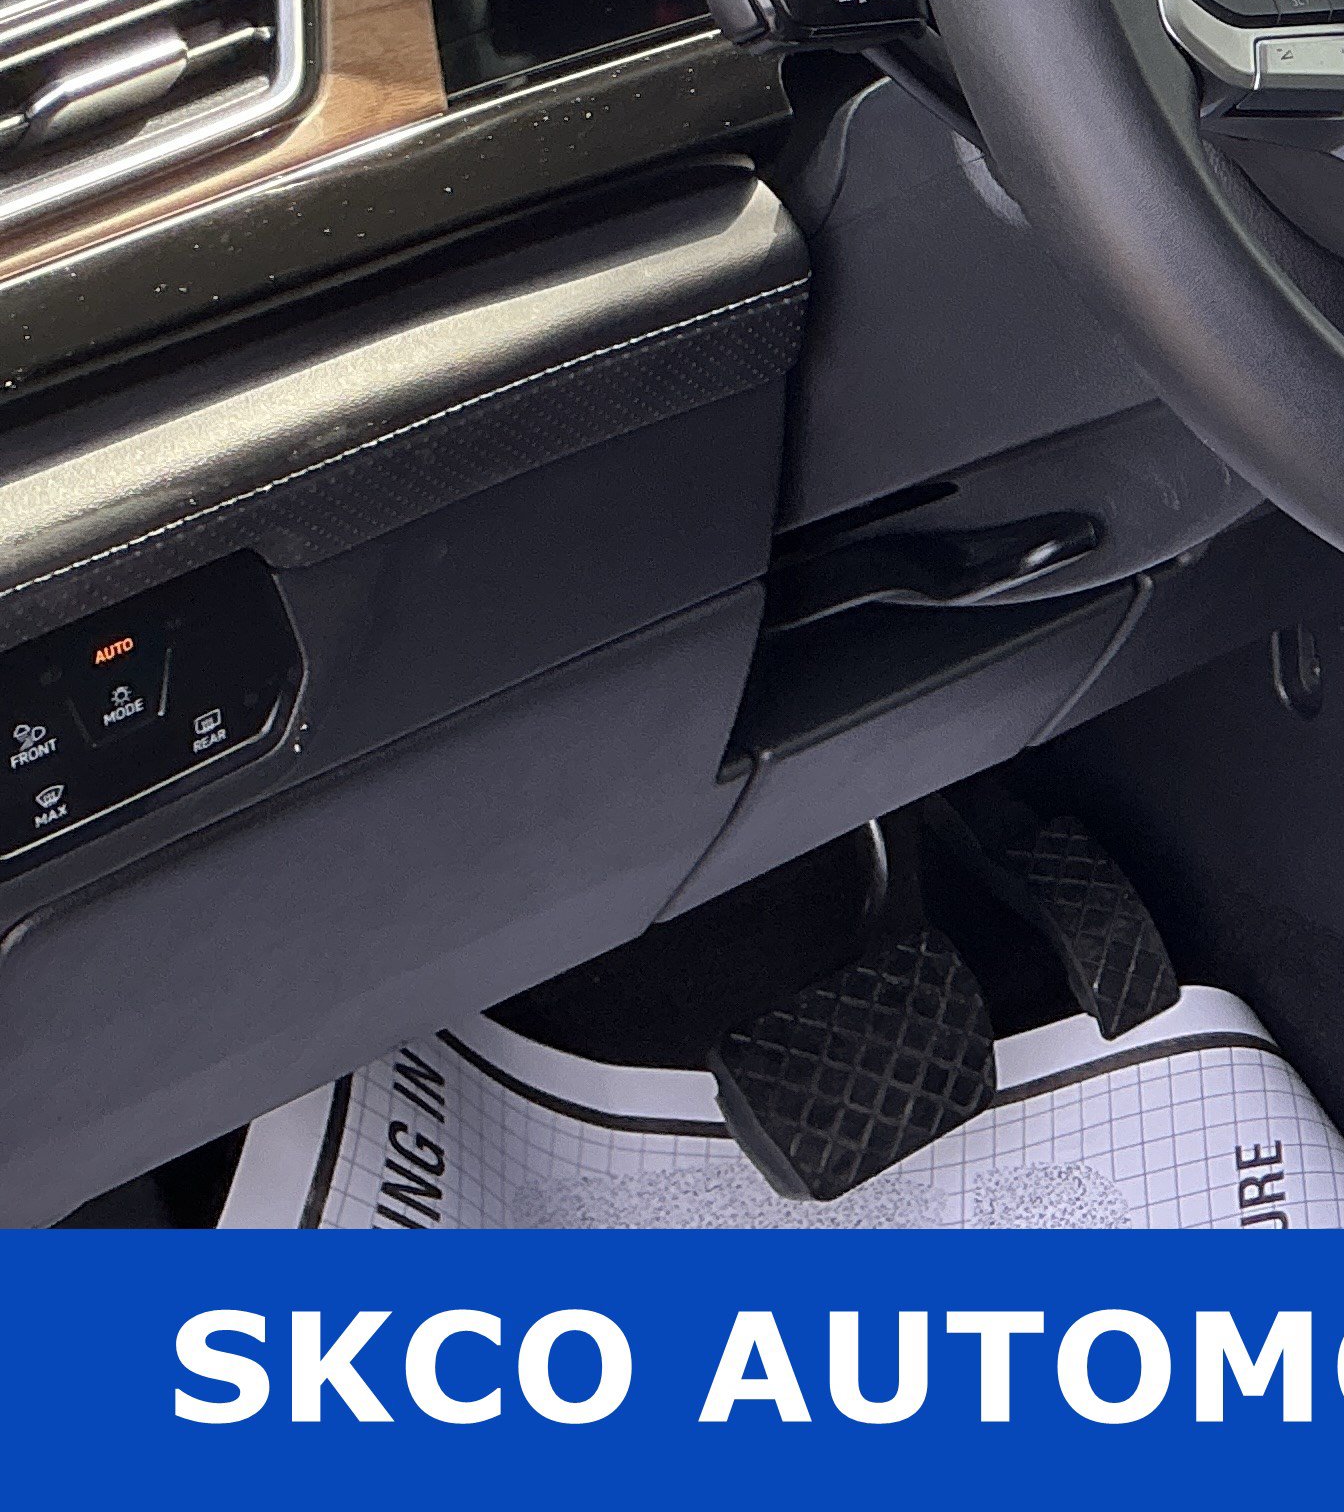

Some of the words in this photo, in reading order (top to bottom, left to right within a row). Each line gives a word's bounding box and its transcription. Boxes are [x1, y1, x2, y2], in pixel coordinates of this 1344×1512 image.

[94, 637, 135, 665] AUTO
[103, 699, 145, 727] MODE
[10, 738, 59, 770] FRONT
[192, 728, 227, 754] REAR
[34, 803, 69, 829] MAX
[392, 1046, 446, 1124] IN
[372, 1119, 446, 1229] ING
